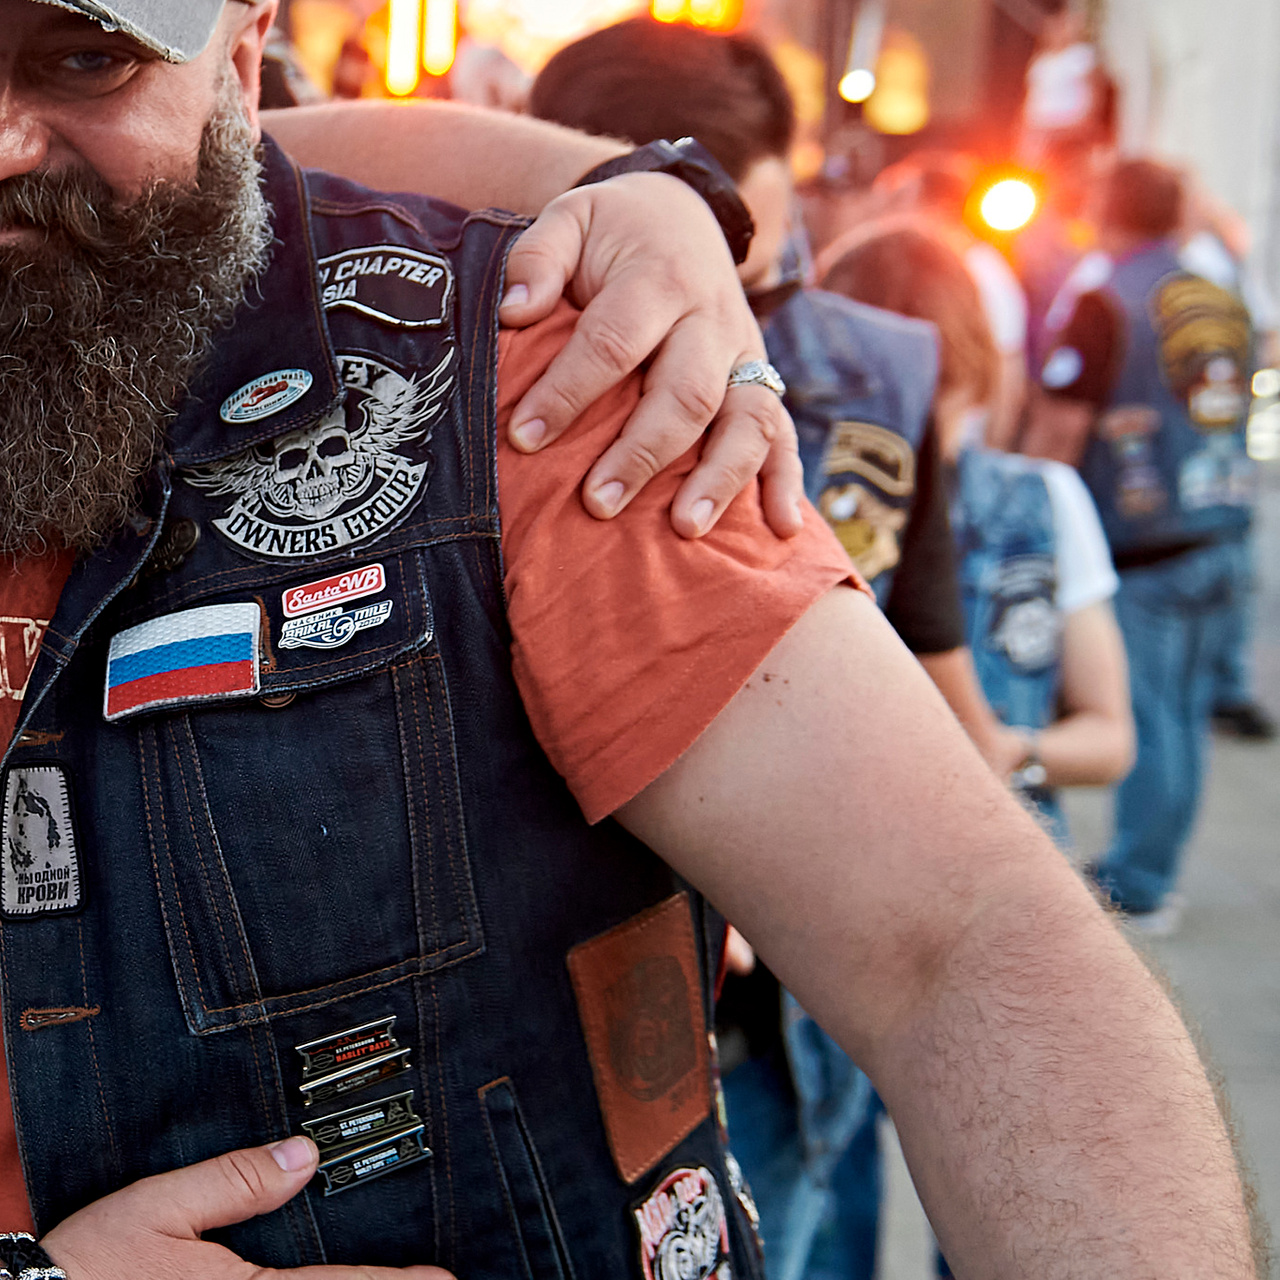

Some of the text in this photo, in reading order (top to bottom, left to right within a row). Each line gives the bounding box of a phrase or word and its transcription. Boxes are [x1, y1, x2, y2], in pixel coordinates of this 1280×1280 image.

[334, 256, 444, 288] CHAPTER
[322, 279, 357, 303] SIA
[227, 470, 418, 554] OWNERS GROUP
[285, 619, 333, 638] BAIKAL
[34, 866, 70, 884] ОДНОЙ
[17, 881, 70, 904] КРОВИ
